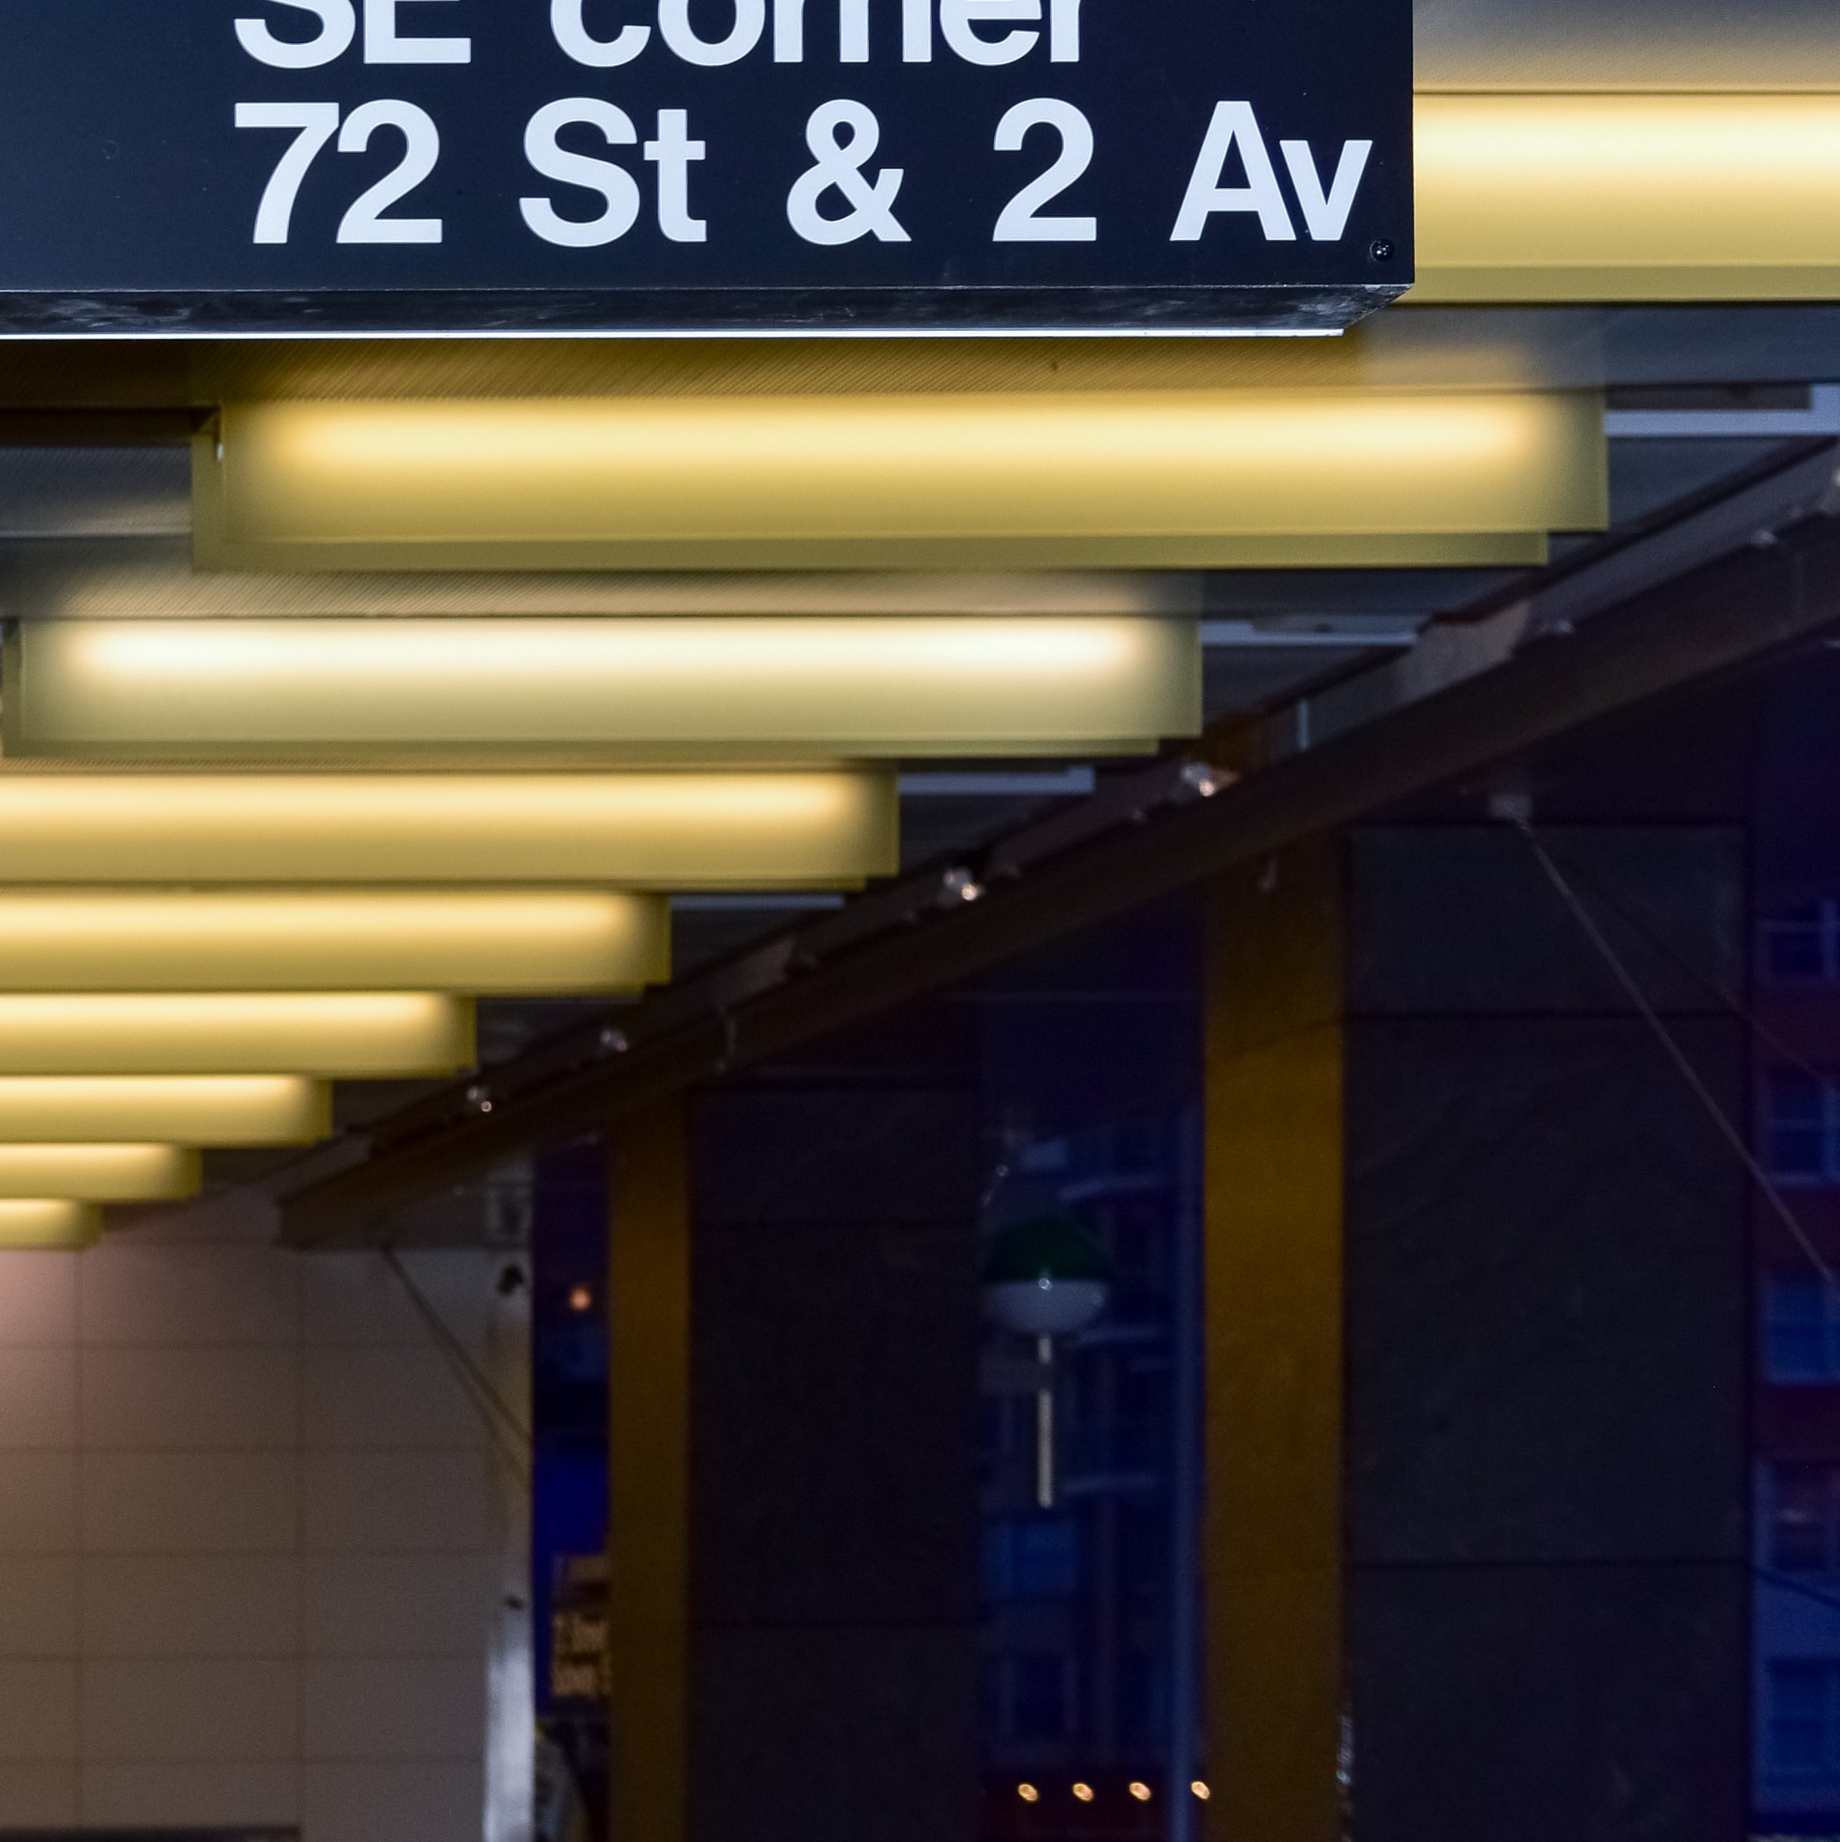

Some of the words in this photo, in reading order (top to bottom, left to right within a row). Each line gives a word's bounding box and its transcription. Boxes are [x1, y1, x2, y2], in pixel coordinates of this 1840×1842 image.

[234, 98, 443, 246] 72
[519, 97, 707, 248] St
[786, 98, 912, 246] &
[992, 97, 1097, 242] 2
[1169, 100, 1373, 242] Av
